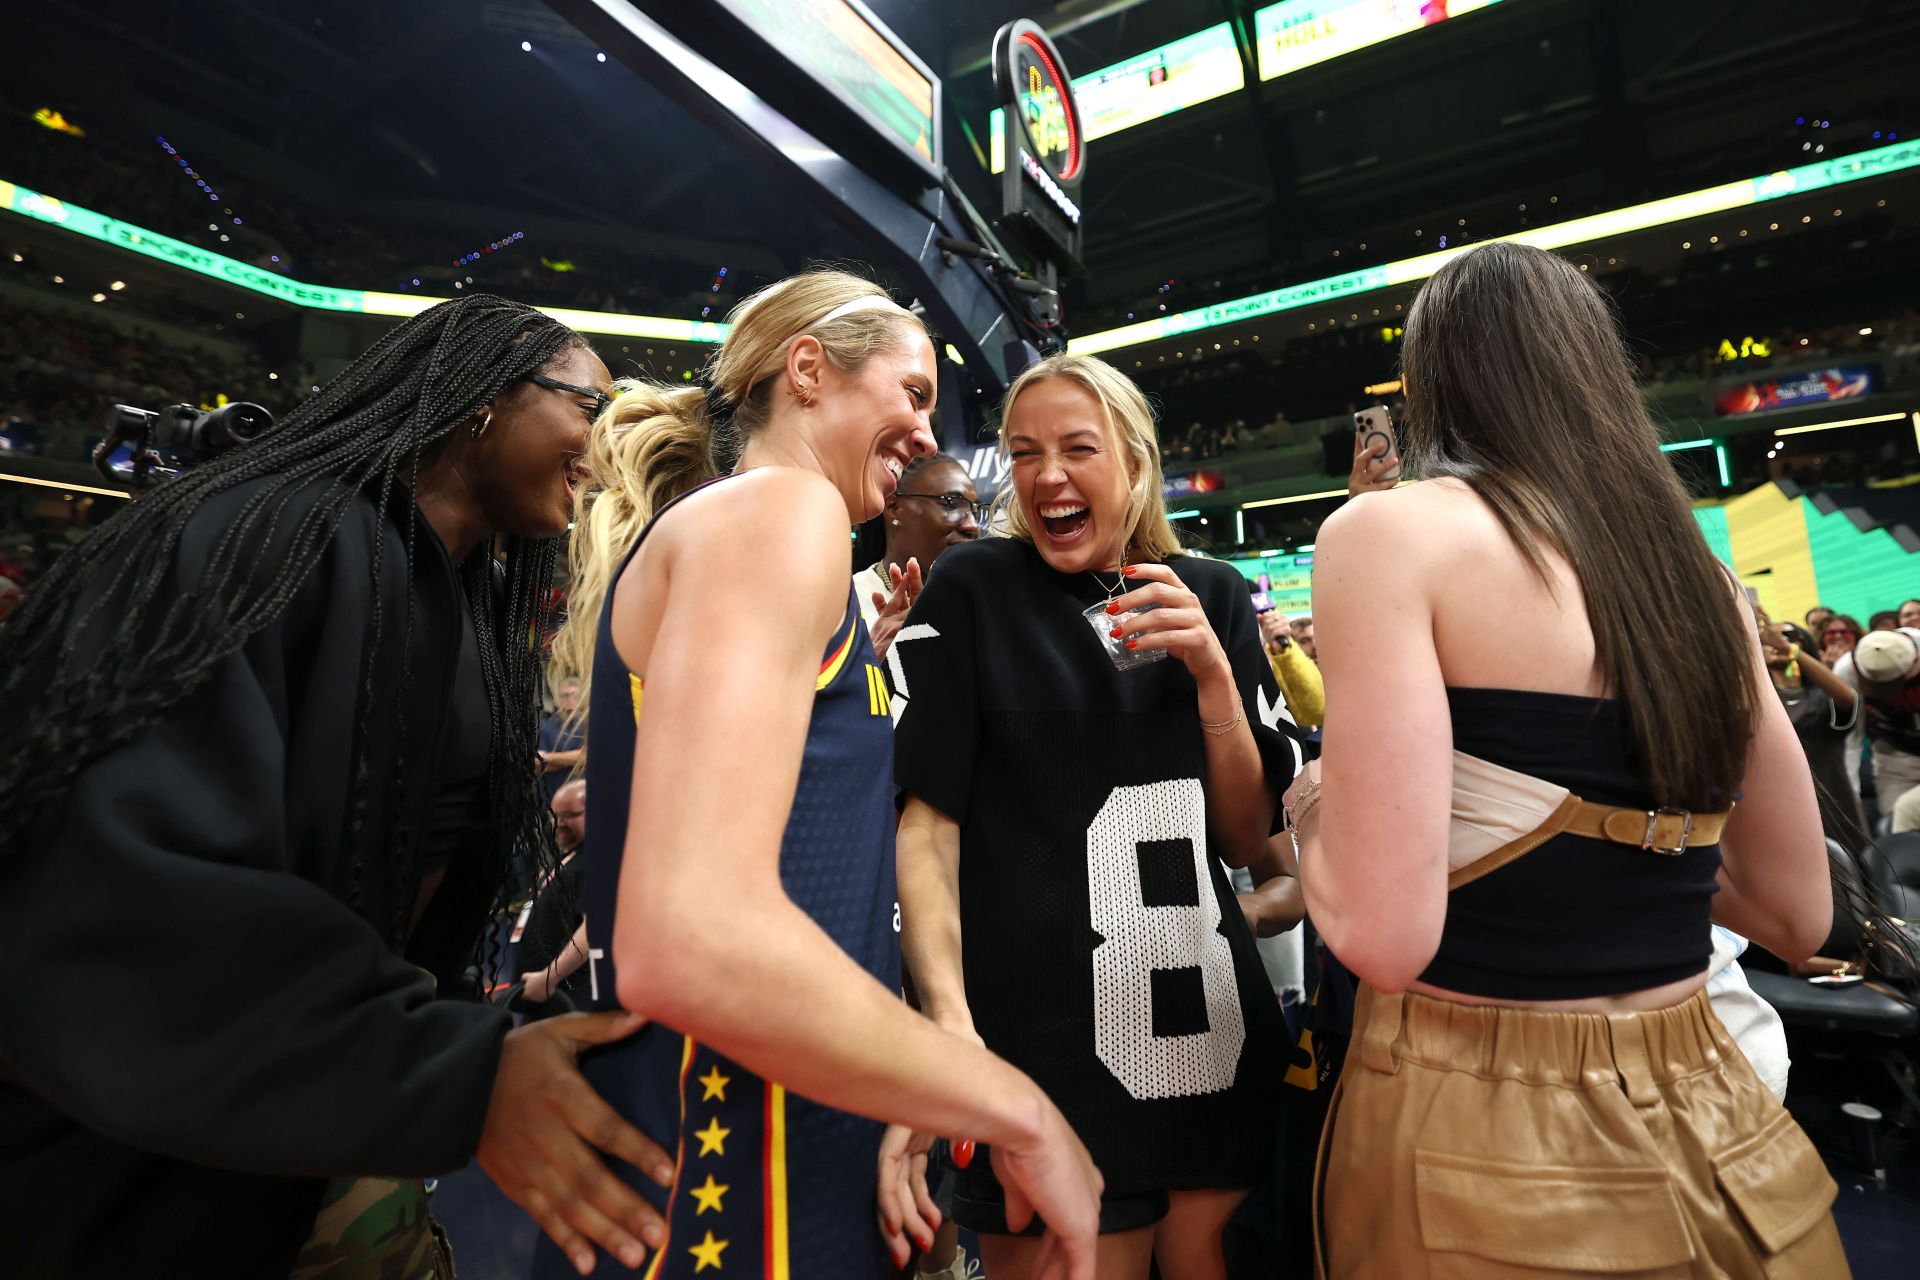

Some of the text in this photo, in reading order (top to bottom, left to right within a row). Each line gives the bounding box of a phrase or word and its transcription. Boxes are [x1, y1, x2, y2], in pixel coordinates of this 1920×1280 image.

[1275, 17, 1338, 54] HULL
[222, 262, 340, 304] CONTEST
[1277, 275, 1366, 304] CONTEST
[957, 446, 1012, 485] lly
[1087, 778, 1246, 1100] 8
